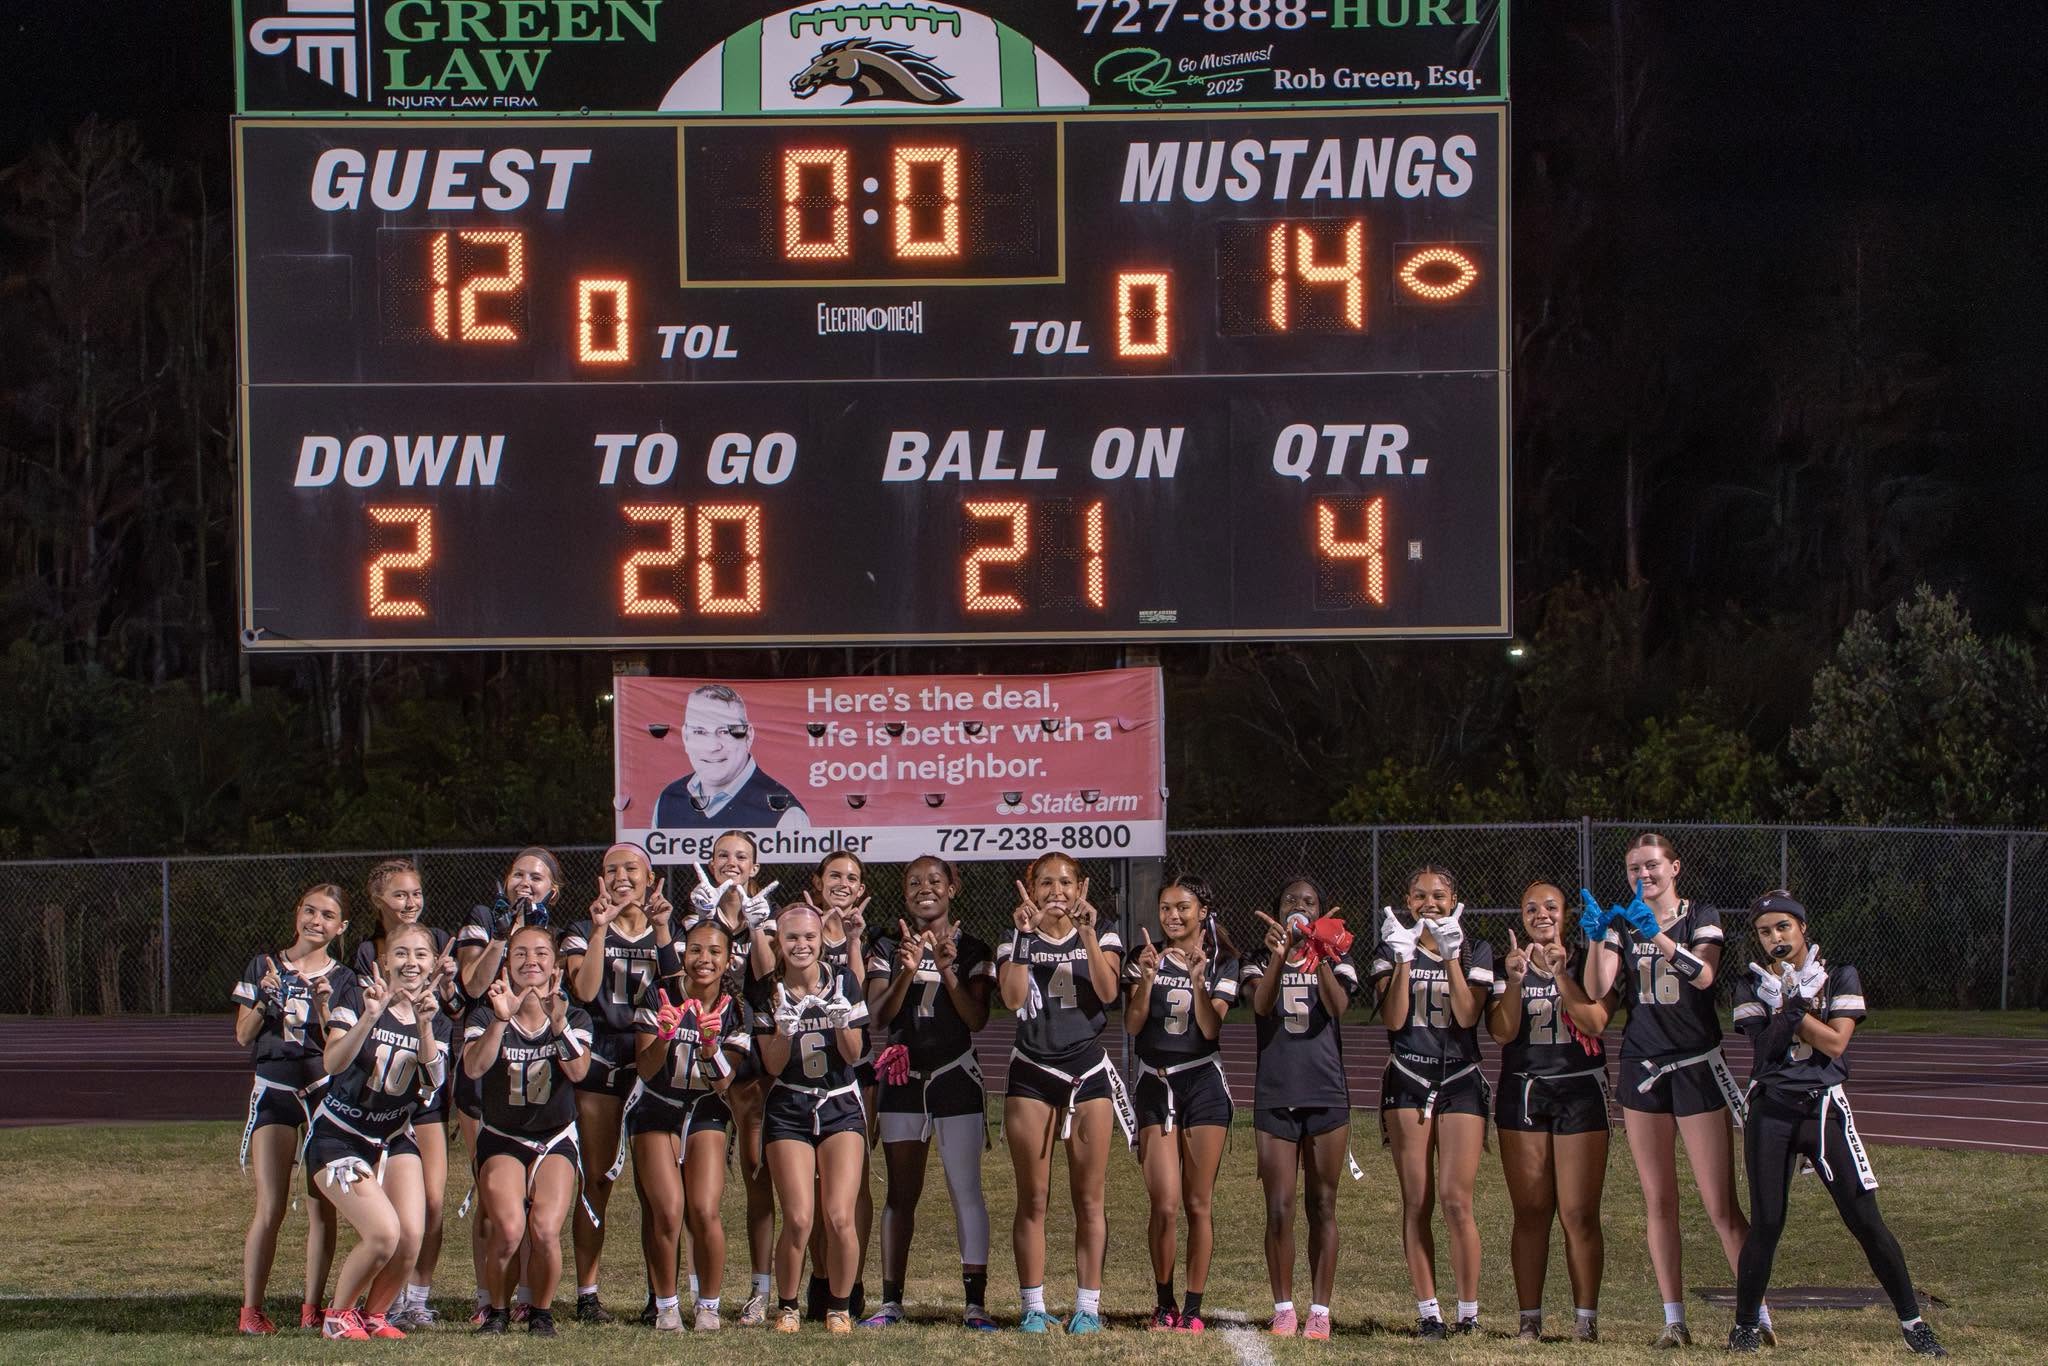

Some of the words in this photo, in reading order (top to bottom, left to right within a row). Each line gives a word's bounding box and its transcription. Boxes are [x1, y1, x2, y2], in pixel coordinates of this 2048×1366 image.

[384, 0, 664, 42] GREEN
[383, 48, 552, 91] LAW
[1206, 78, 1244, 96] 2025
[1273, 68, 1326, 90] Rob
[1333, 67, 1421, 90] Green,
[1427, 65, 1482, 91] Esq.
[387, 96, 446, 109] INJURY
[451, 96, 489, 107] LAW
[493, 96, 538, 107] FIRM
[311, 147, 593, 212] GUEST
[1120, 134, 1478, 203] MUSTANGS
[431, 230, 524, 342] 12
[1270, 221, 1363, 332] 14
[577, 278, 630, 364] 0
[1008, 320, 1091, 355] TOL
[1118, 272, 1168, 356] 0
[657, 325, 739, 359] TOL
[294, 434, 505, 488] DOWN
[594, 433, 679, 485] TO
[706, 432, 798, 486] GO
[882, 430, 1059, 482] BALL
[1089, 427, 1186, 480] ON
[1272, 423, 1430, 482] QTR.
[369, 507, 433, 617] 2
[622, 505, 761, 614] 20
[963, 502, 1103, 611] 21
[1317, 497, 1384, 605] 4
[807, 687, 912, 713] Here's
[918, 685, 974, 712] the
[982, 682, 1060, 713] deal,
[866, 720, 893, 746] is
[900, 719, 1004, 745] better
[1094, 720, 1113, 741] a
[808, 754, 888, 788] good
[897, 752, 1047, 786] neighbor.
[644, 831, 714, 860] Greg
[936, 824, 1131, 852] 727-238-8800
[1030, 948, 1088, 964] MUSTANGS
[1280, 972, 1319, 986] STANG
[1408, 968, 1448, 980] MUSTA
[1636, 955, 1681, 1005] 16
[612, 958, 657, 1006] 17
[912, 969, 942, 1018] 7
[1048, 961, 1078, 1009] 4
[1153, 974, 1212, 992] MUSTAS
[1520, 984, 1559, 998] MUSTA
[1163, 988, 1193, 1035] 3
[1282, 986, 1310, 1034] 5
[1527, 996, 1572, 1045] 21
[370, 1026, 420, 1052] MUSTAN
[800, 1031, 829, 1078] 6
[1400, 1053, 1440, 1065] MOUR
[362, 1043, 418, 1097] 10
[507, 1059, 553, 1107] 18
